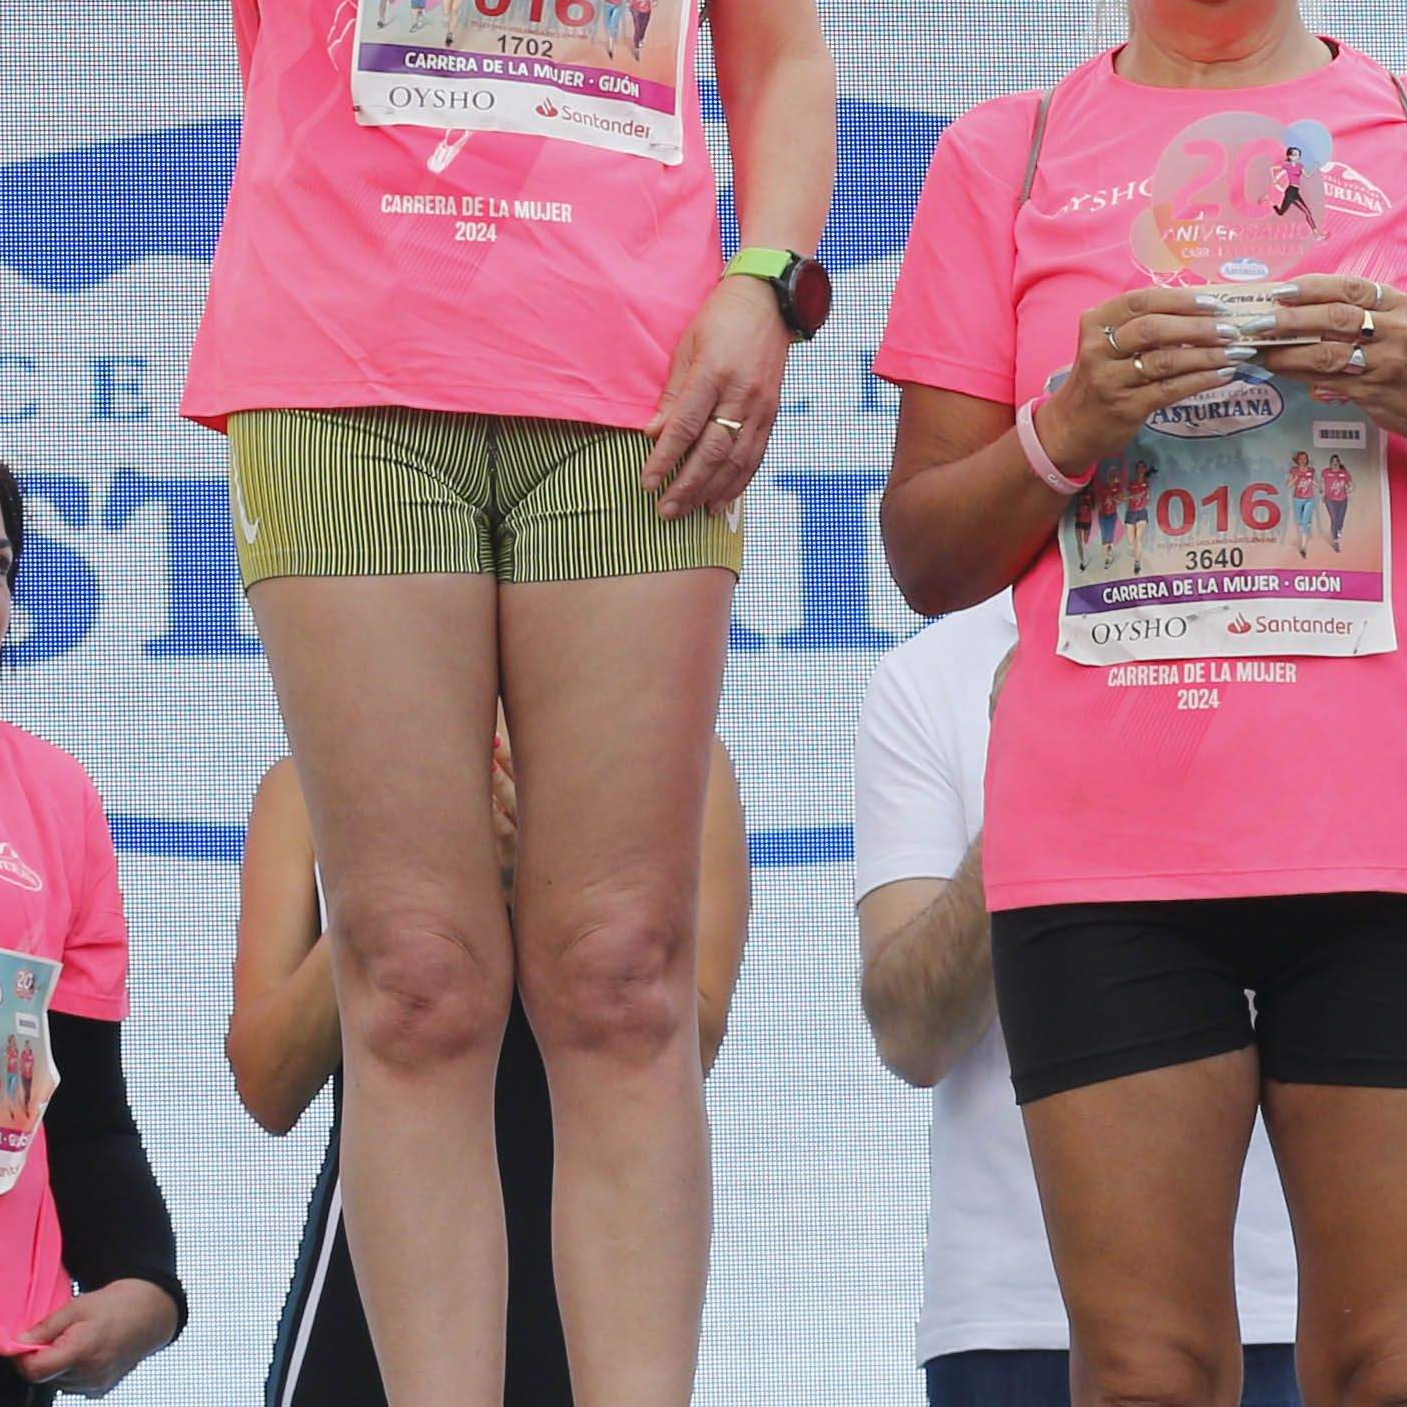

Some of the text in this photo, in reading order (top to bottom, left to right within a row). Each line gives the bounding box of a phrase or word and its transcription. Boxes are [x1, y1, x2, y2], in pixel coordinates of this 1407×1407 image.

[497, 34, 554, 59] 1702
[405, 51, 640, 99] CARRERA DE LA MUJER GIJÓN
[389, 85, 496, 112] OYSHO
[561, 105, 652, 140] Santander
[381, 194, 573, 223] CARRERA DE LA MUJER
[455, 221, 498, 243] 2024
[1150, 398, 1274, 425] ASTURIANA
[1156, 481, 1283, 538] 016
[1185, 546, 1244, 571] 3640
[1103, 570, 1341, 605] CARRERA DE LA MUJER GIJÓN
[1092, 615, 1188, 646] OYSHO
[1255, 615, 1354, 636] Santander
[1107, 660, 1298, 688] CARRERA DE LA MUJER
[1177, 688, 1221, 711] 2024
